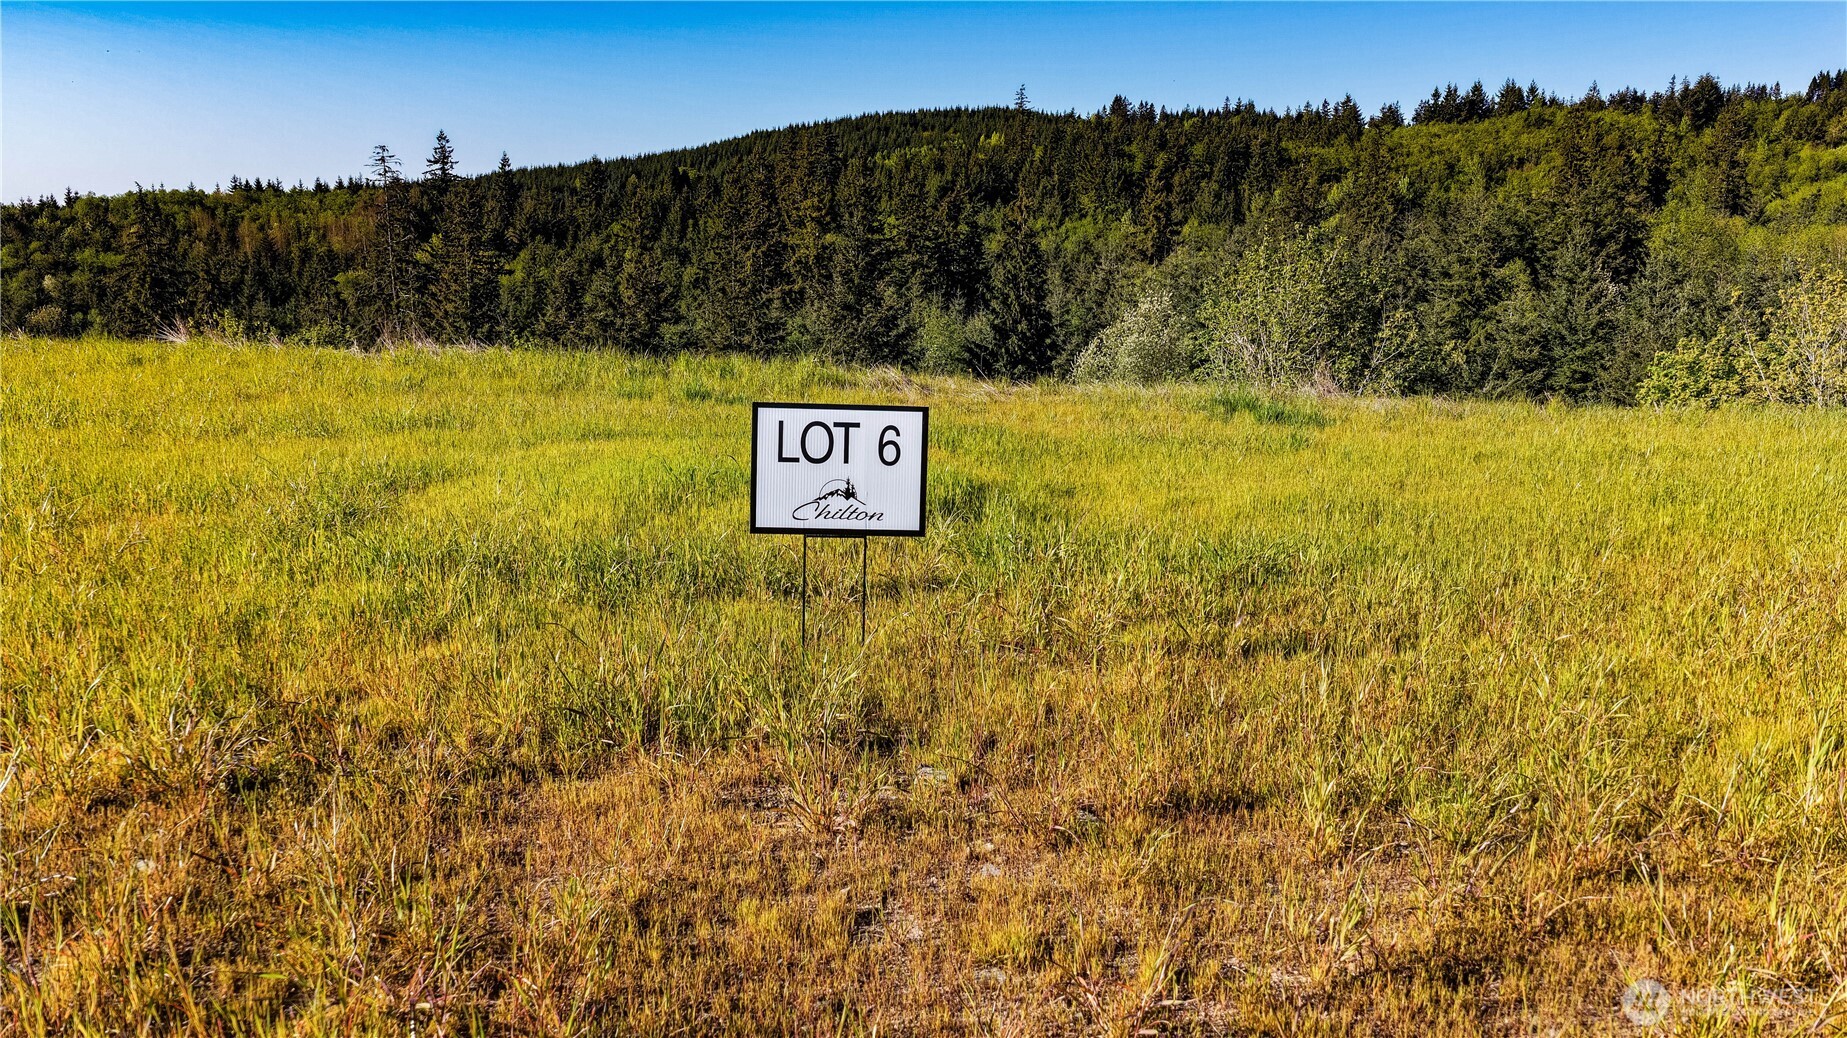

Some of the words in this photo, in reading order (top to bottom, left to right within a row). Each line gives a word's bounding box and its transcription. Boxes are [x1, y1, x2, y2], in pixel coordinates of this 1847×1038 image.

[777, 420, 861, 465] LOT
[878, 424, 902, 467] 6
[792, 500, 884, 522] Chilton
